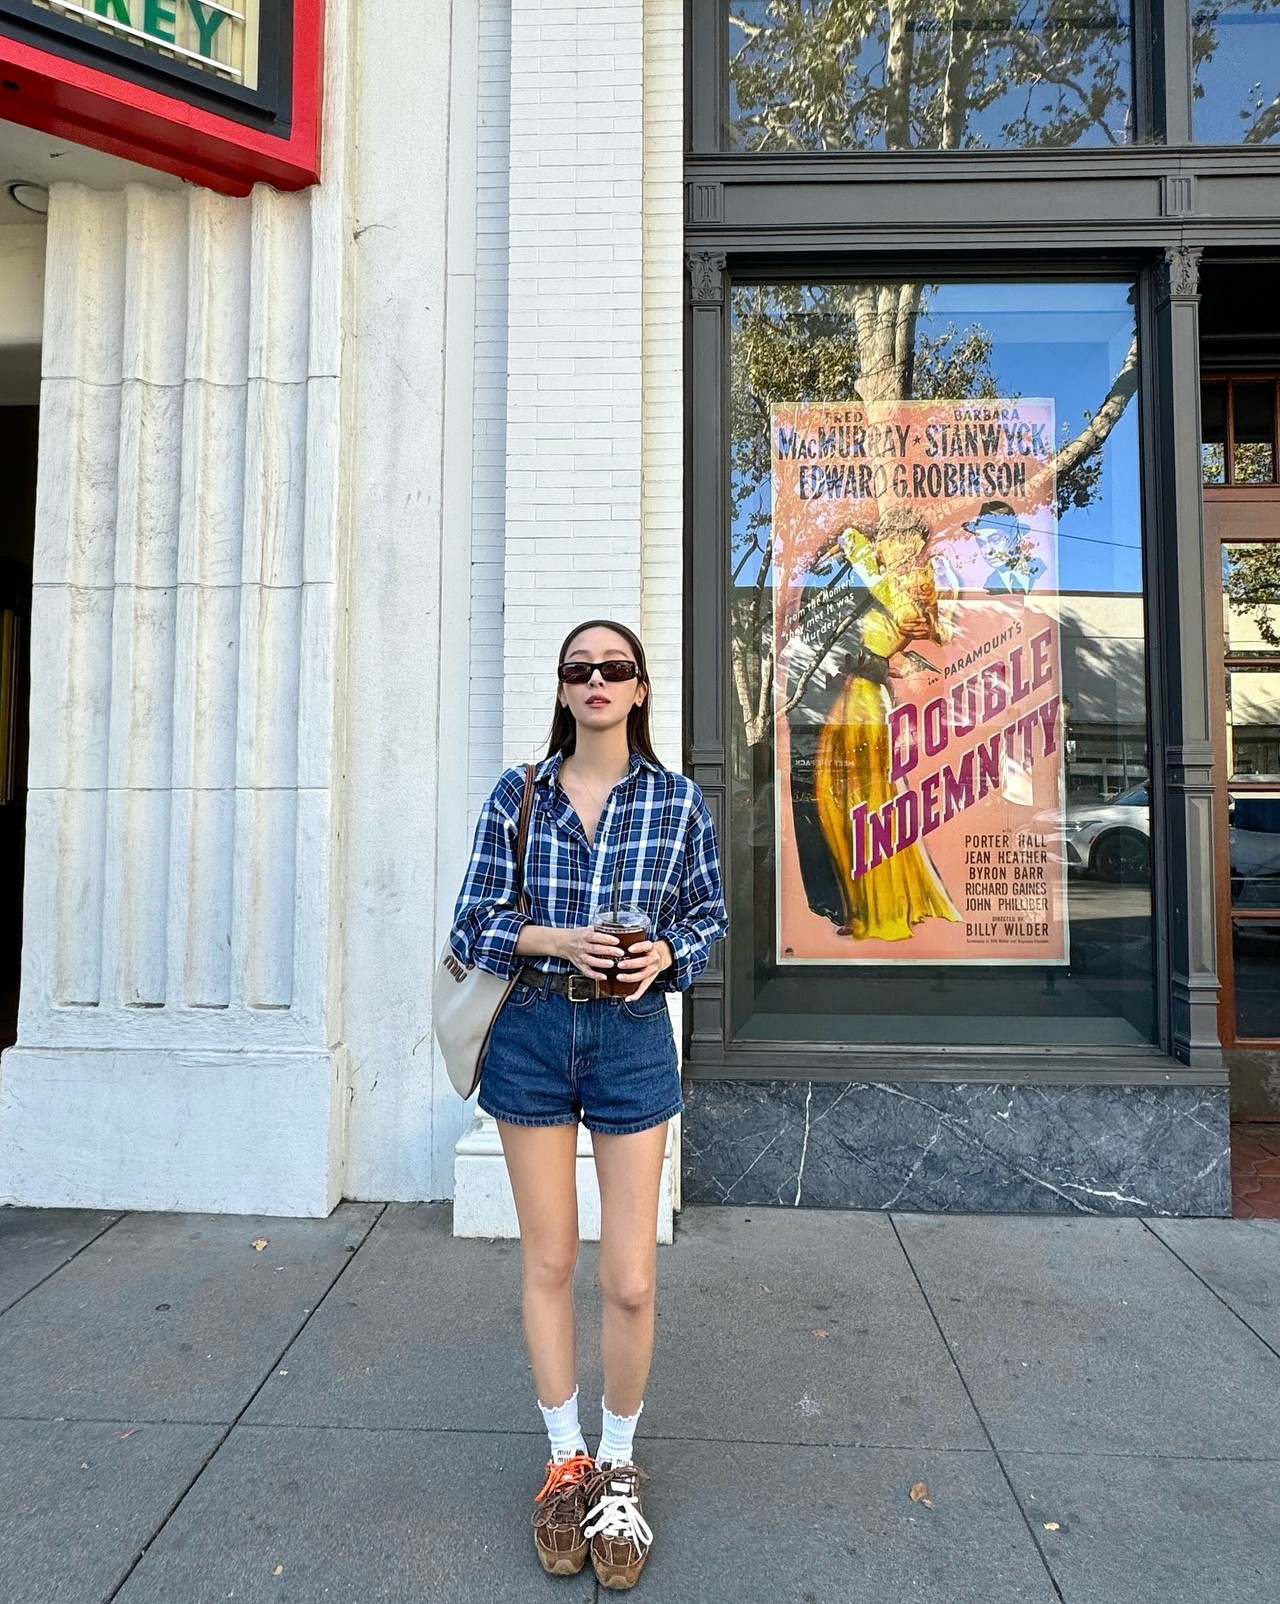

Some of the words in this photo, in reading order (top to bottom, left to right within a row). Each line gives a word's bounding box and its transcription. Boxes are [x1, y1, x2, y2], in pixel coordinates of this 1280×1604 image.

[825, 411, 863, 424] FRED
[954, 408, 1020, 421] BARBARA
[925, 422, 1048, 457] STANWYCK
[799, 463, 888, 500] EDWARD
[806, 610, 824, 628] met
[836, 592, 855, 609] was
[944, 621, 1022, 680] PARAMOUNT'S
[887, 627, 1053, 783] DOUBLE
[851, 695, 1060, 881] INDEMNITY
[965, 834, 1010, 849] PORTER
[1018, 834, 1048, 848] HALL
[965, 850, 991, 865] JEAN
[998, 850, 1047, 864] HEATHER
[969, 866, 1007, 880] BYRON
[1014, 866, 1044, 880] BARR
[965, 882, 1008, 896] RICHARD
[1012, 882, 1047, 896] GAINES
[966, 898, 992, 911] JOHN
[998, 898, 1049, 911] PHILLIBER
[966, 923, 998, 937] BILLY
[1004, 923, 1049, 937] WILDER
